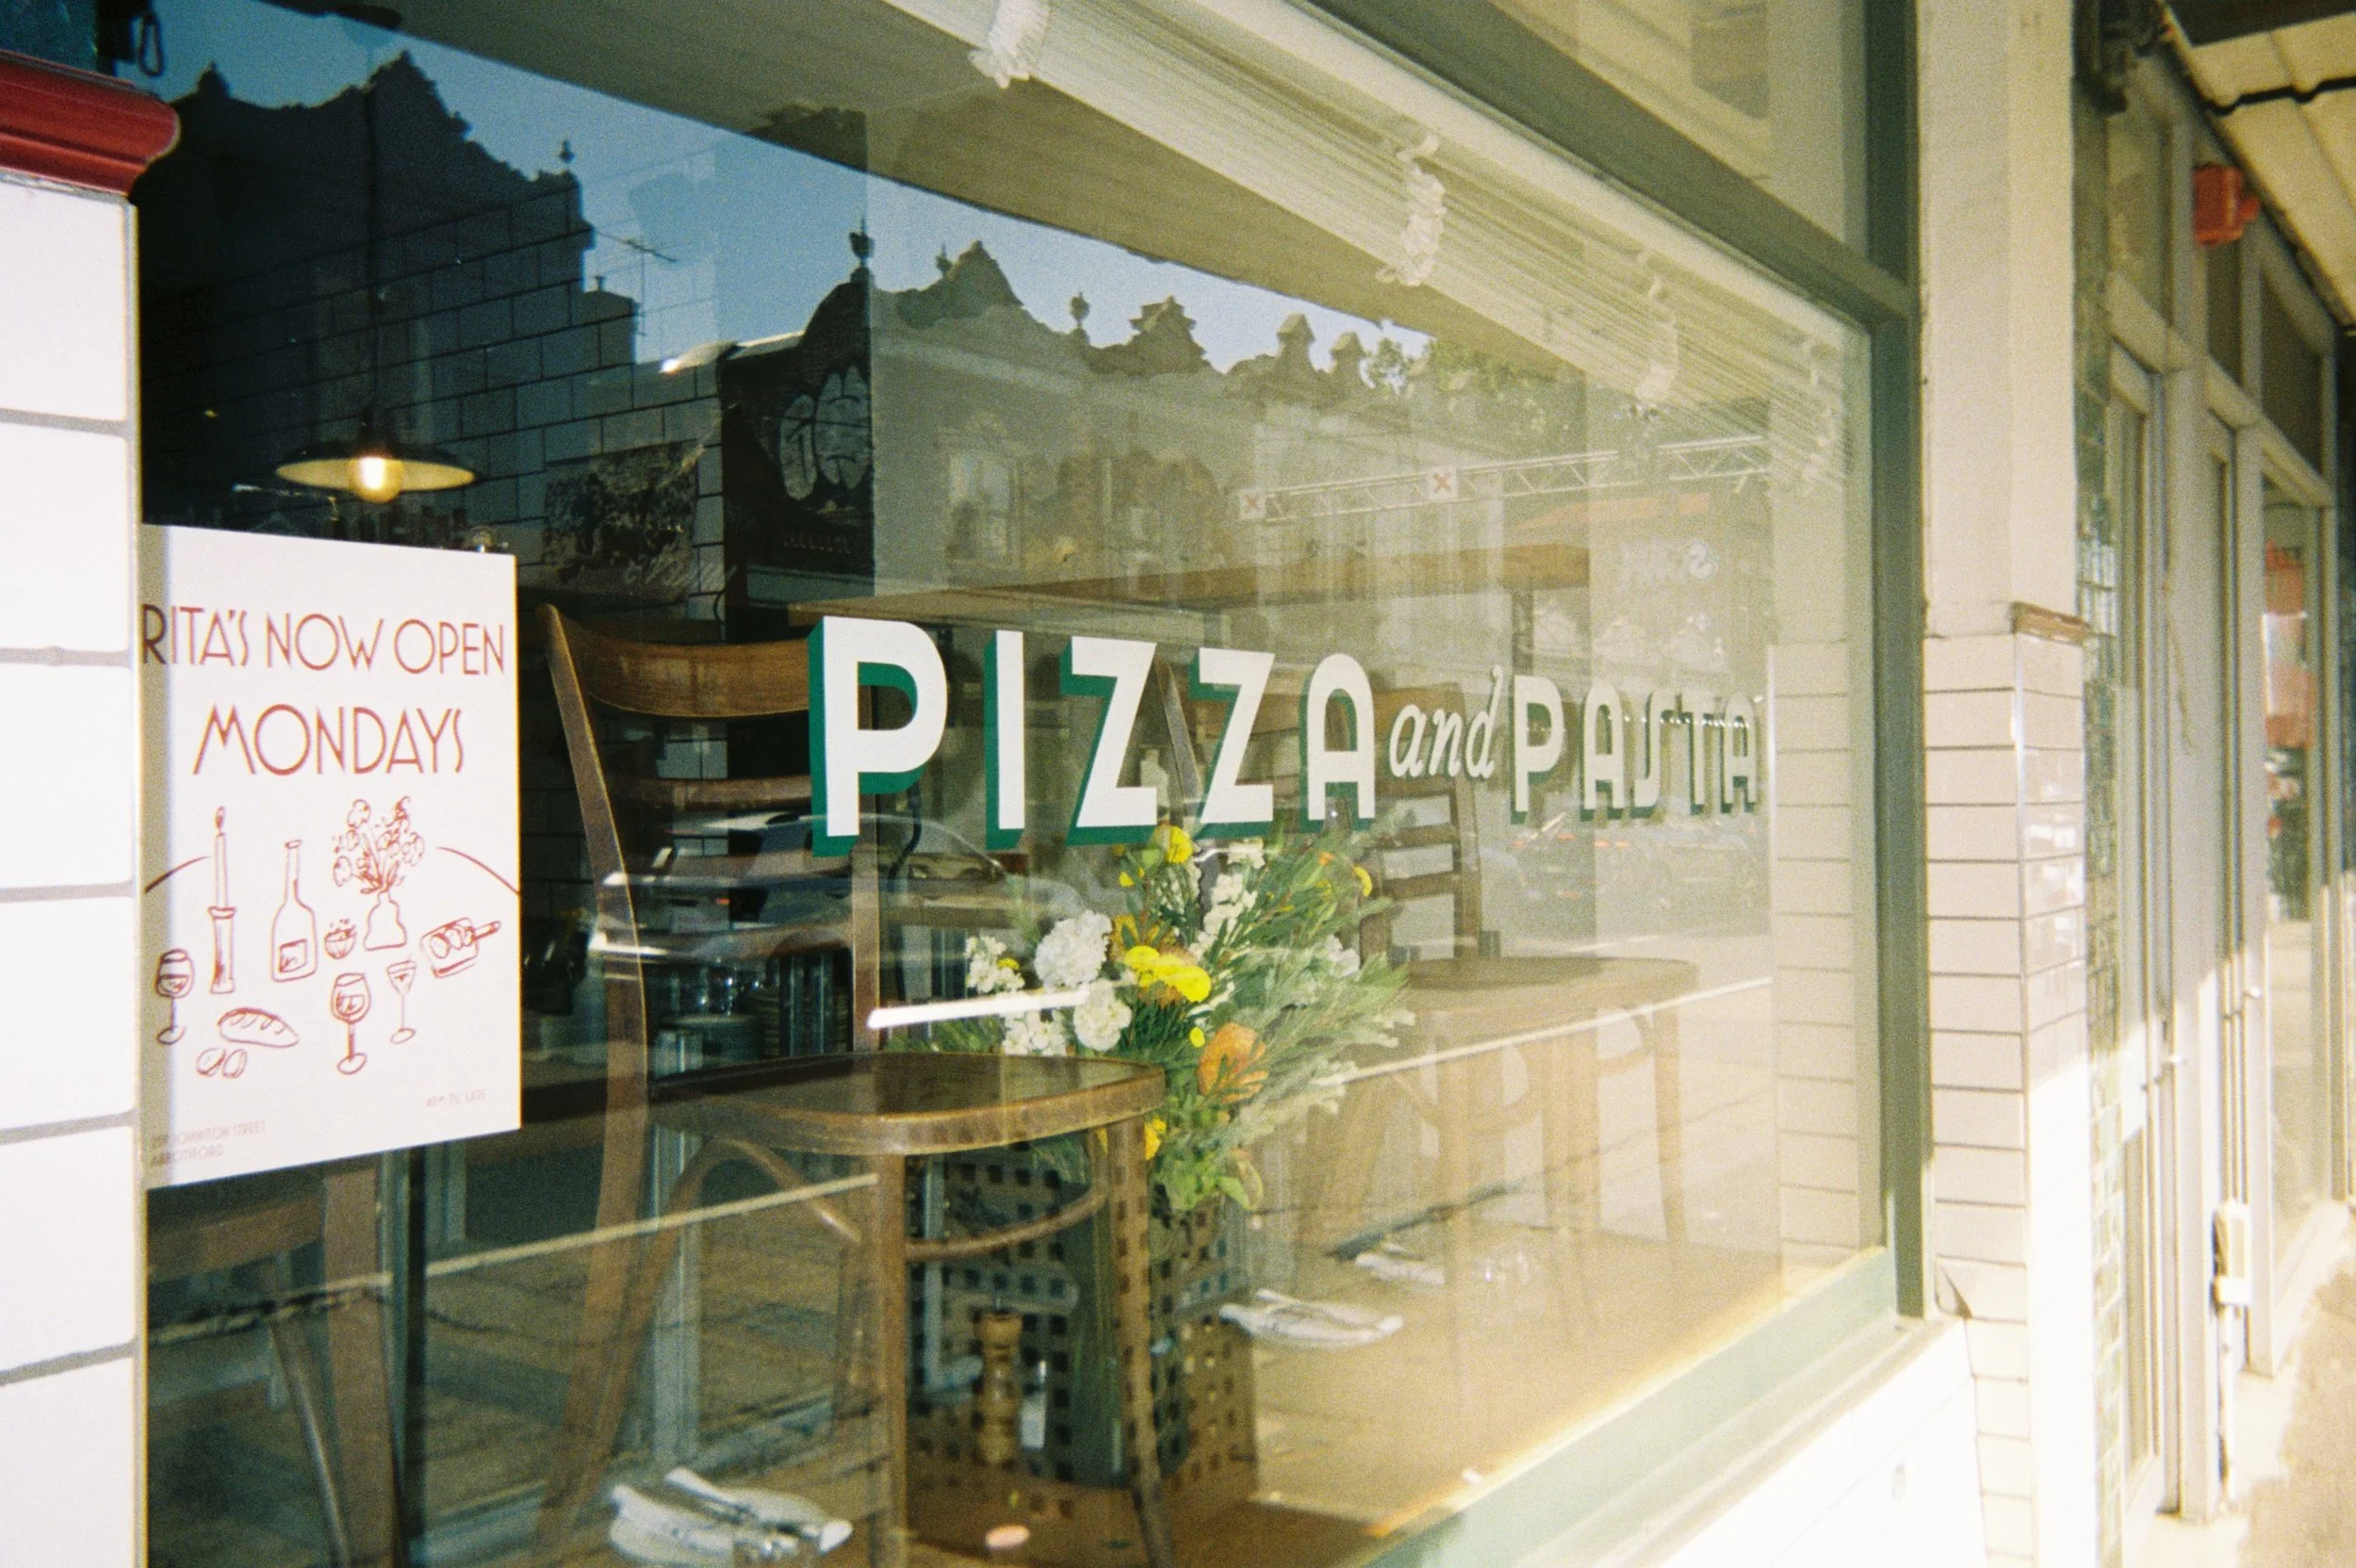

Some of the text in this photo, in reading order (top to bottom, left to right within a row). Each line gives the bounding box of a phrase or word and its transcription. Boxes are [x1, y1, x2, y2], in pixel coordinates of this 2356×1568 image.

[140, 604, 504, 676] RITA'S NOW OPEN
[192, 702, 464, 776] MONDAYS
[809, 615, 1758, 857] PIZZA and PASTA
[233, 1119, 266, 1137] STREET
